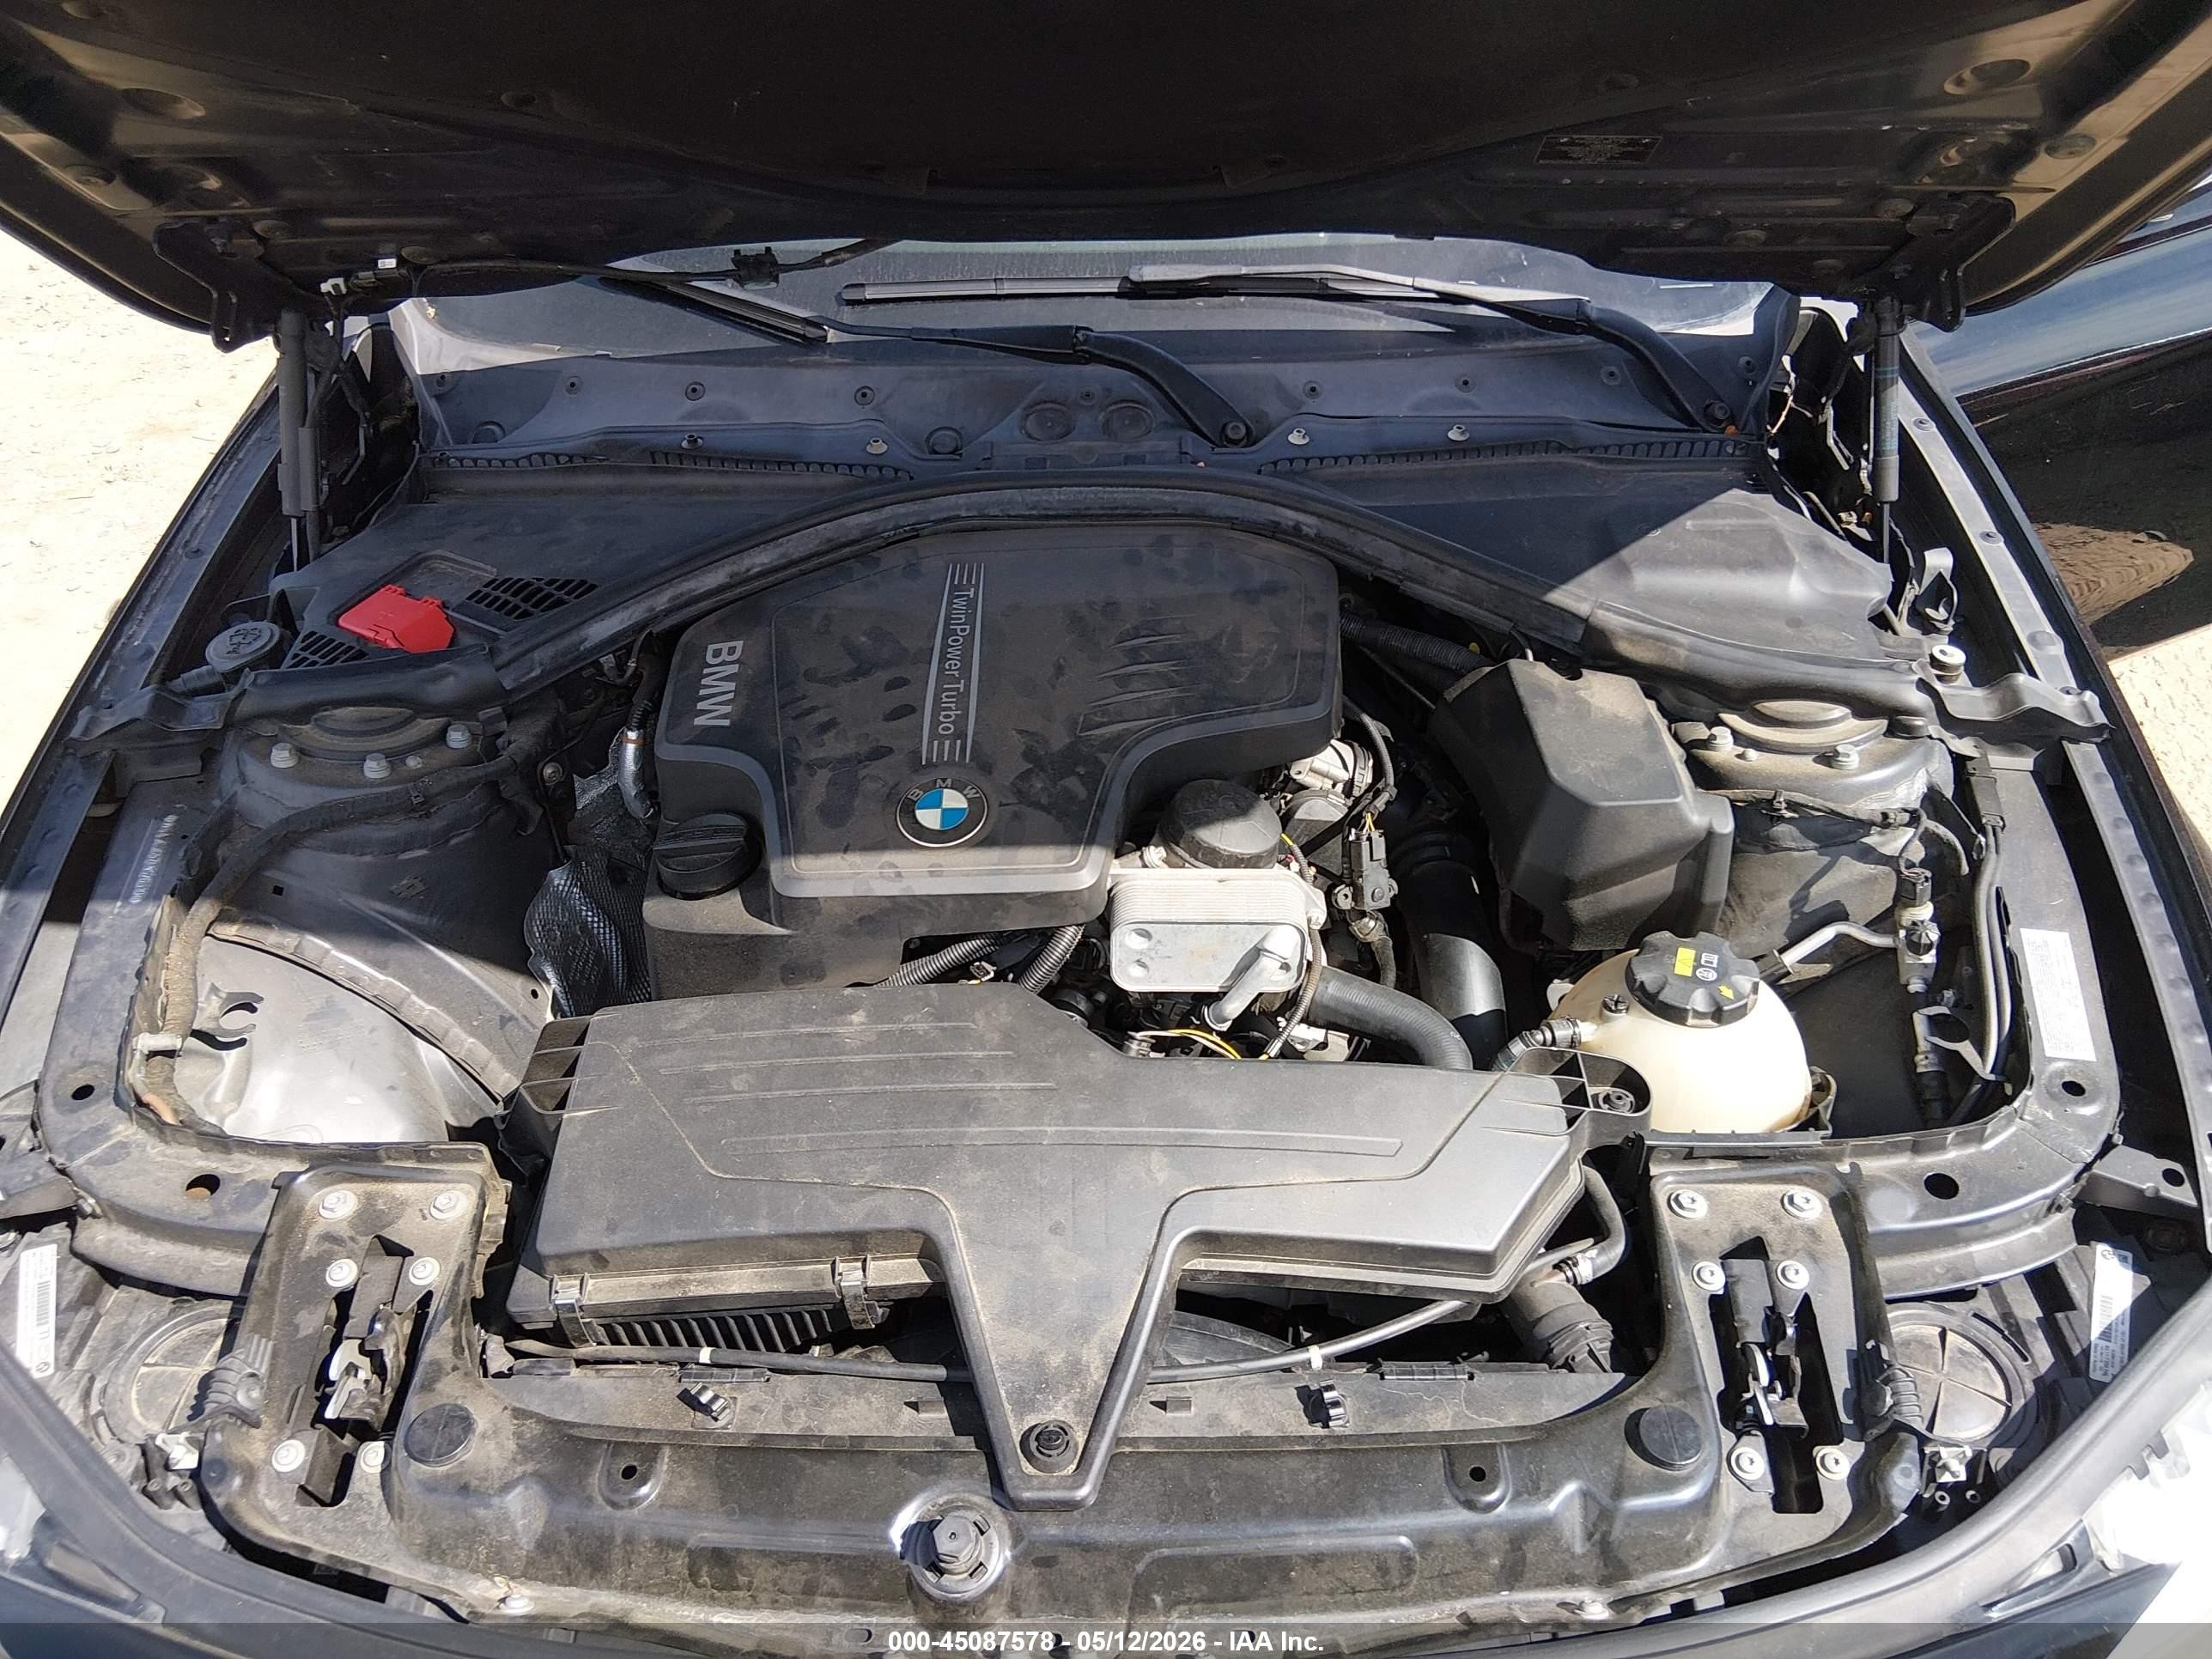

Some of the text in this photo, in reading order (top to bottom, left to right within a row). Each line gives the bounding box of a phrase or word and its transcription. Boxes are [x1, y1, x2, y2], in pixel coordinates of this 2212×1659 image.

[693, 640, 744, 726] BMW
[938, 587, 975, 735] TwinPower Turbo
[906, 778, 981, 801] BMW
